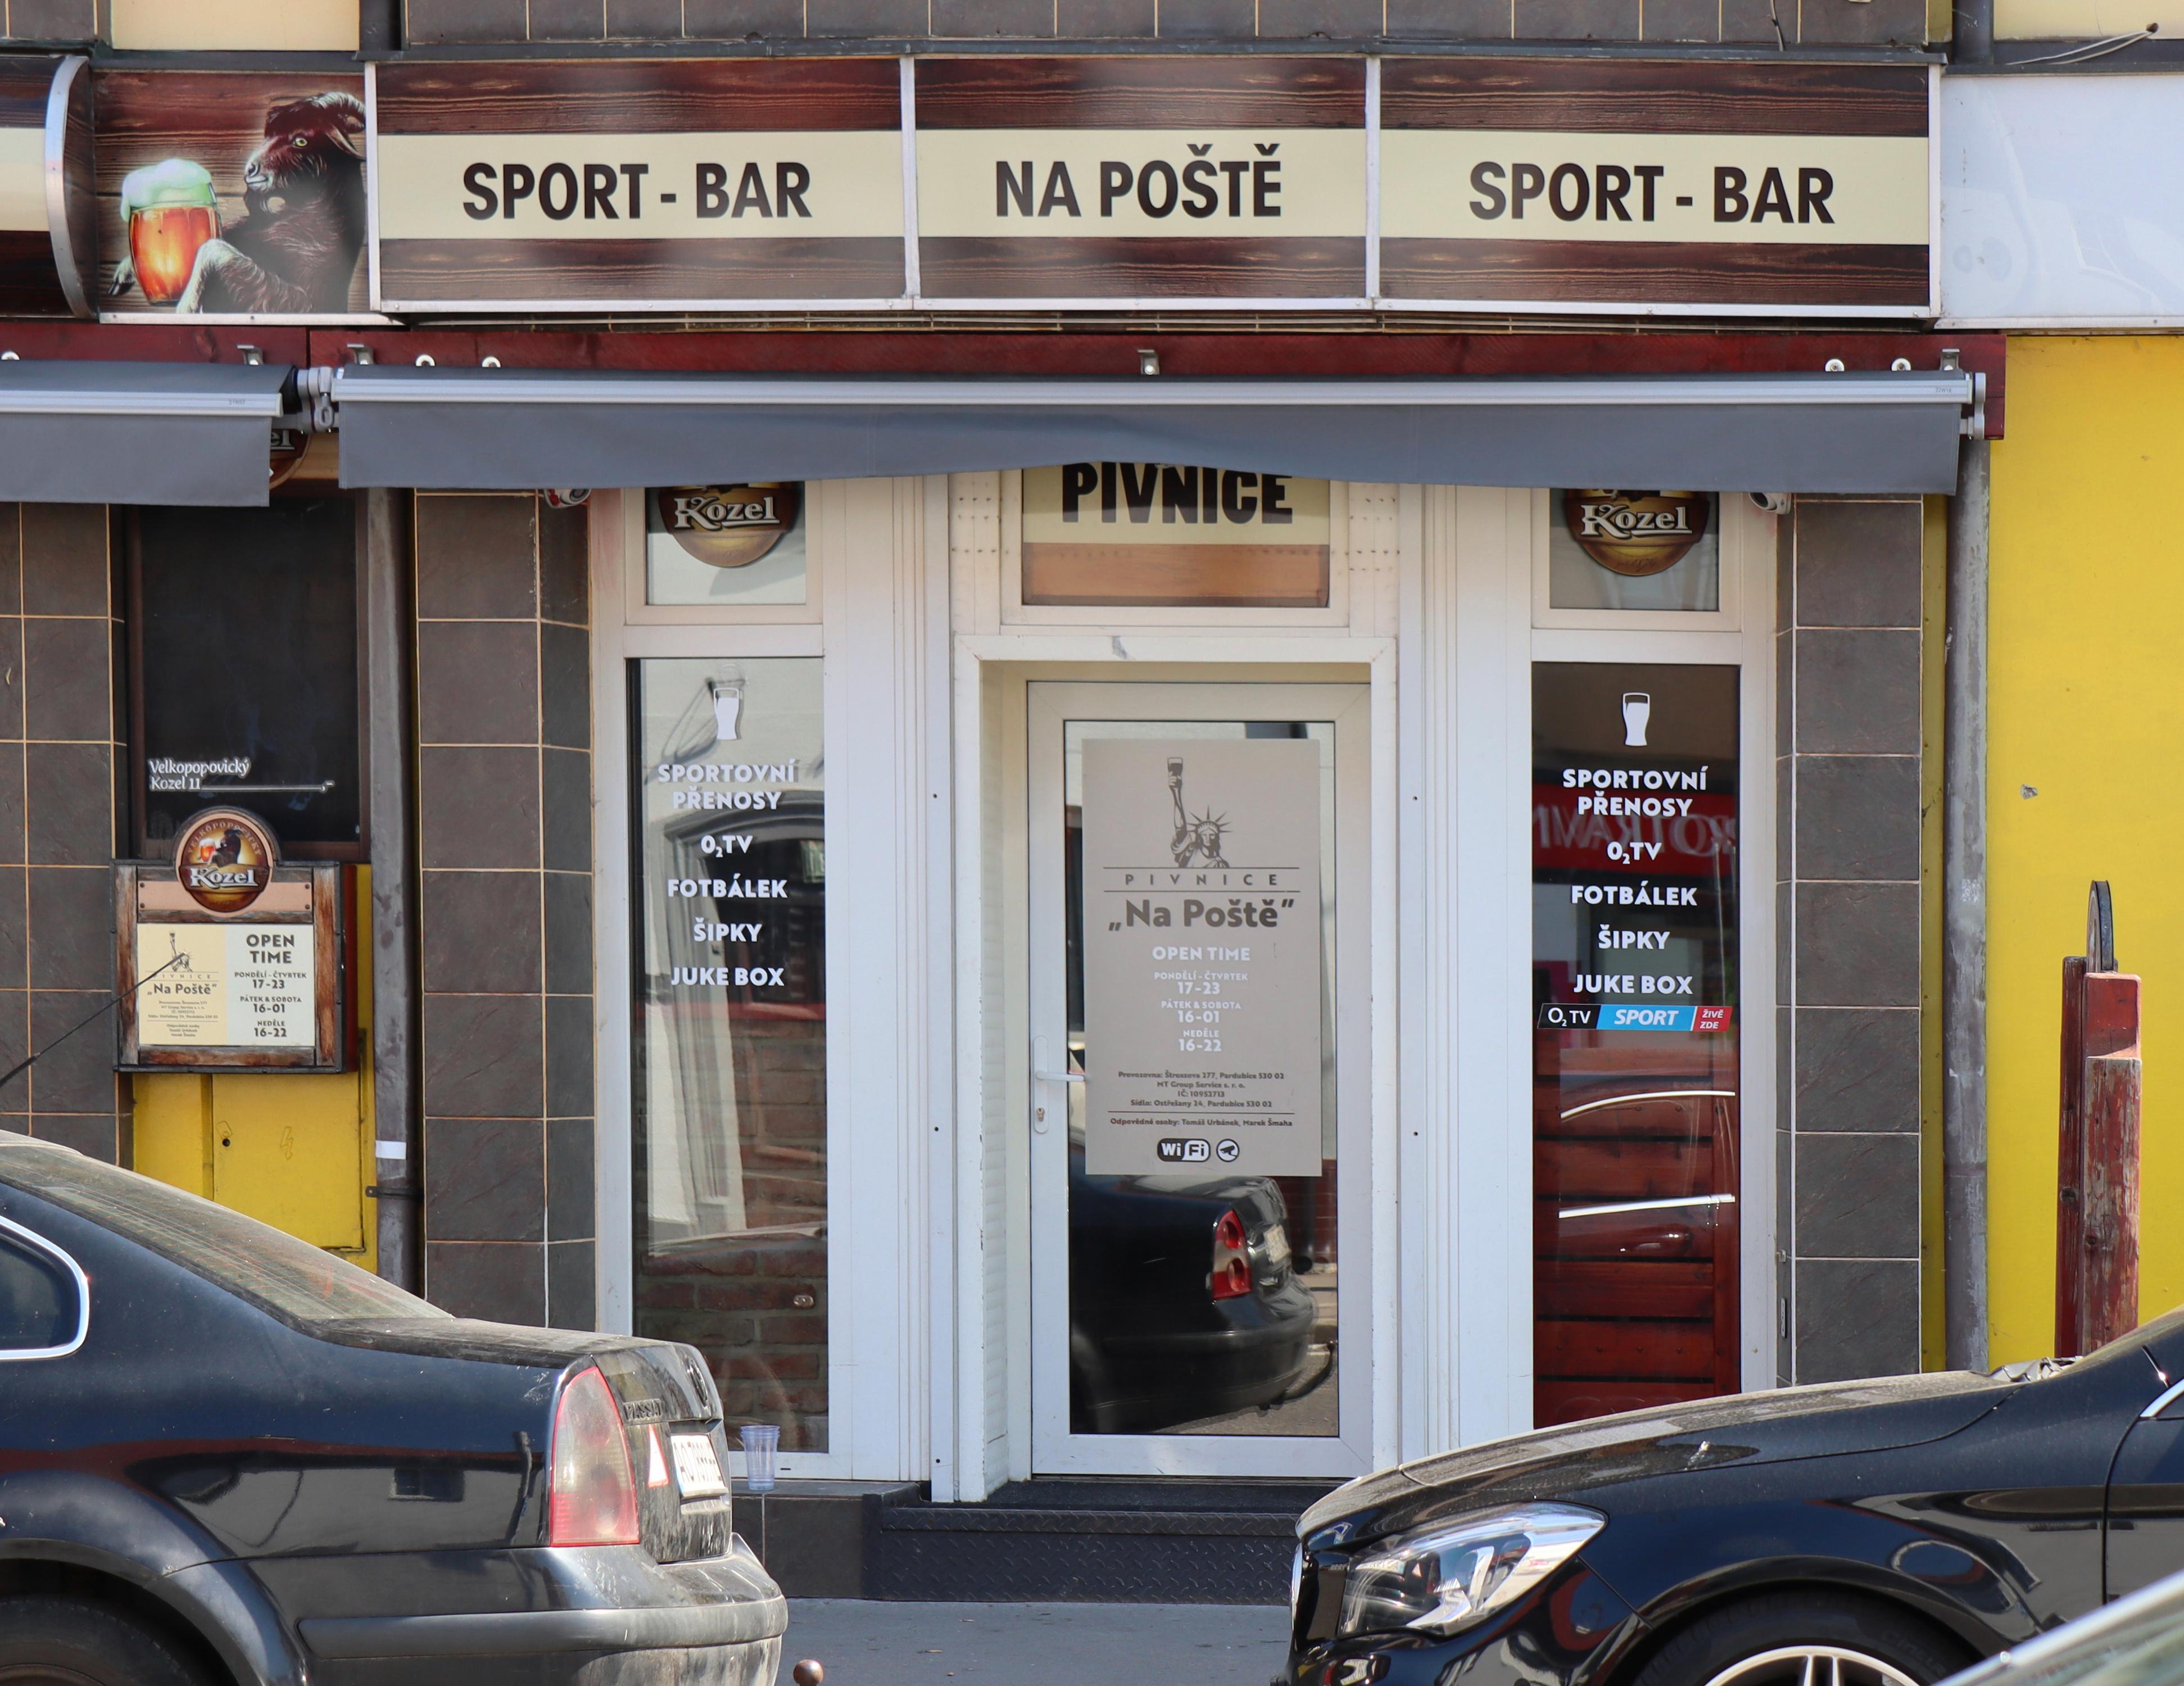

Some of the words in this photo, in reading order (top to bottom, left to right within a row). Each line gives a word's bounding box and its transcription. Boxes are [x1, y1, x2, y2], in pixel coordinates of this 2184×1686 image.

[463, 162, 649, 220] SPORT
[696, 162, 813, 219] BAR
[996, 161, 1081, 217] NA
[1100, 144, 1281, 219] POŠTĚ
[1470, 161, 1664, 221] SPORT
[1714, 166, 1834, 224] BAR
[1062, 462, 1293, 524] PIVNICE
[674, 497, 780, 529] Kozel
[1581, 505, 1692, 538] Kozel
[148, 757, 250, 777] Velkopopovický
[658, 759, 795, 783] SPORTOVNÍ
[151, 776, 185, 790] Kozel
[189, 778, 200, 789] 11
[1562, 766, 1708, 791] SPORTOVNÍ
[673, 786, 781, 810] PŘENOSY
[1578, 791, 1693, 817] PŘENOSY
[190, 868, 259, 889] Kozel
[668, 873, 787, 898] FOTBÁLEK
[1126, 874, 1277, 885] PIVNICE
[1571, 881, 1697, 906] FOTBÁLEK
[246, 935, 294, 947] OPEN
[694, 918, 762, 942] ŠIPKY
[1598, 924, 1670, 950] ŠIPKY
[250, 951, 292, 963] TIME
[1152, 946, 1202, 960] OPEN
[1207, 947, 1250, 961] TIME
[671, 967, 728, 986] JUKE
[735, 968, 784, 986] BOX
[1154, 971, 1197, 980] PONDĚLÍ
[1204, 971, 1248, 980] ČTVRTEK
[1574, 975, 1634, 994] JUKE
[1641, 975, 1693, 995] BOX
[1161, 999, 1191, 1008] PÁTEK
[1702, 1009, 1724, 1018] ŽIVĚ
[1614, 1009, 1679, 1025] SPORT
[1183, 1028, 1220, 1037] NEDĚLE
